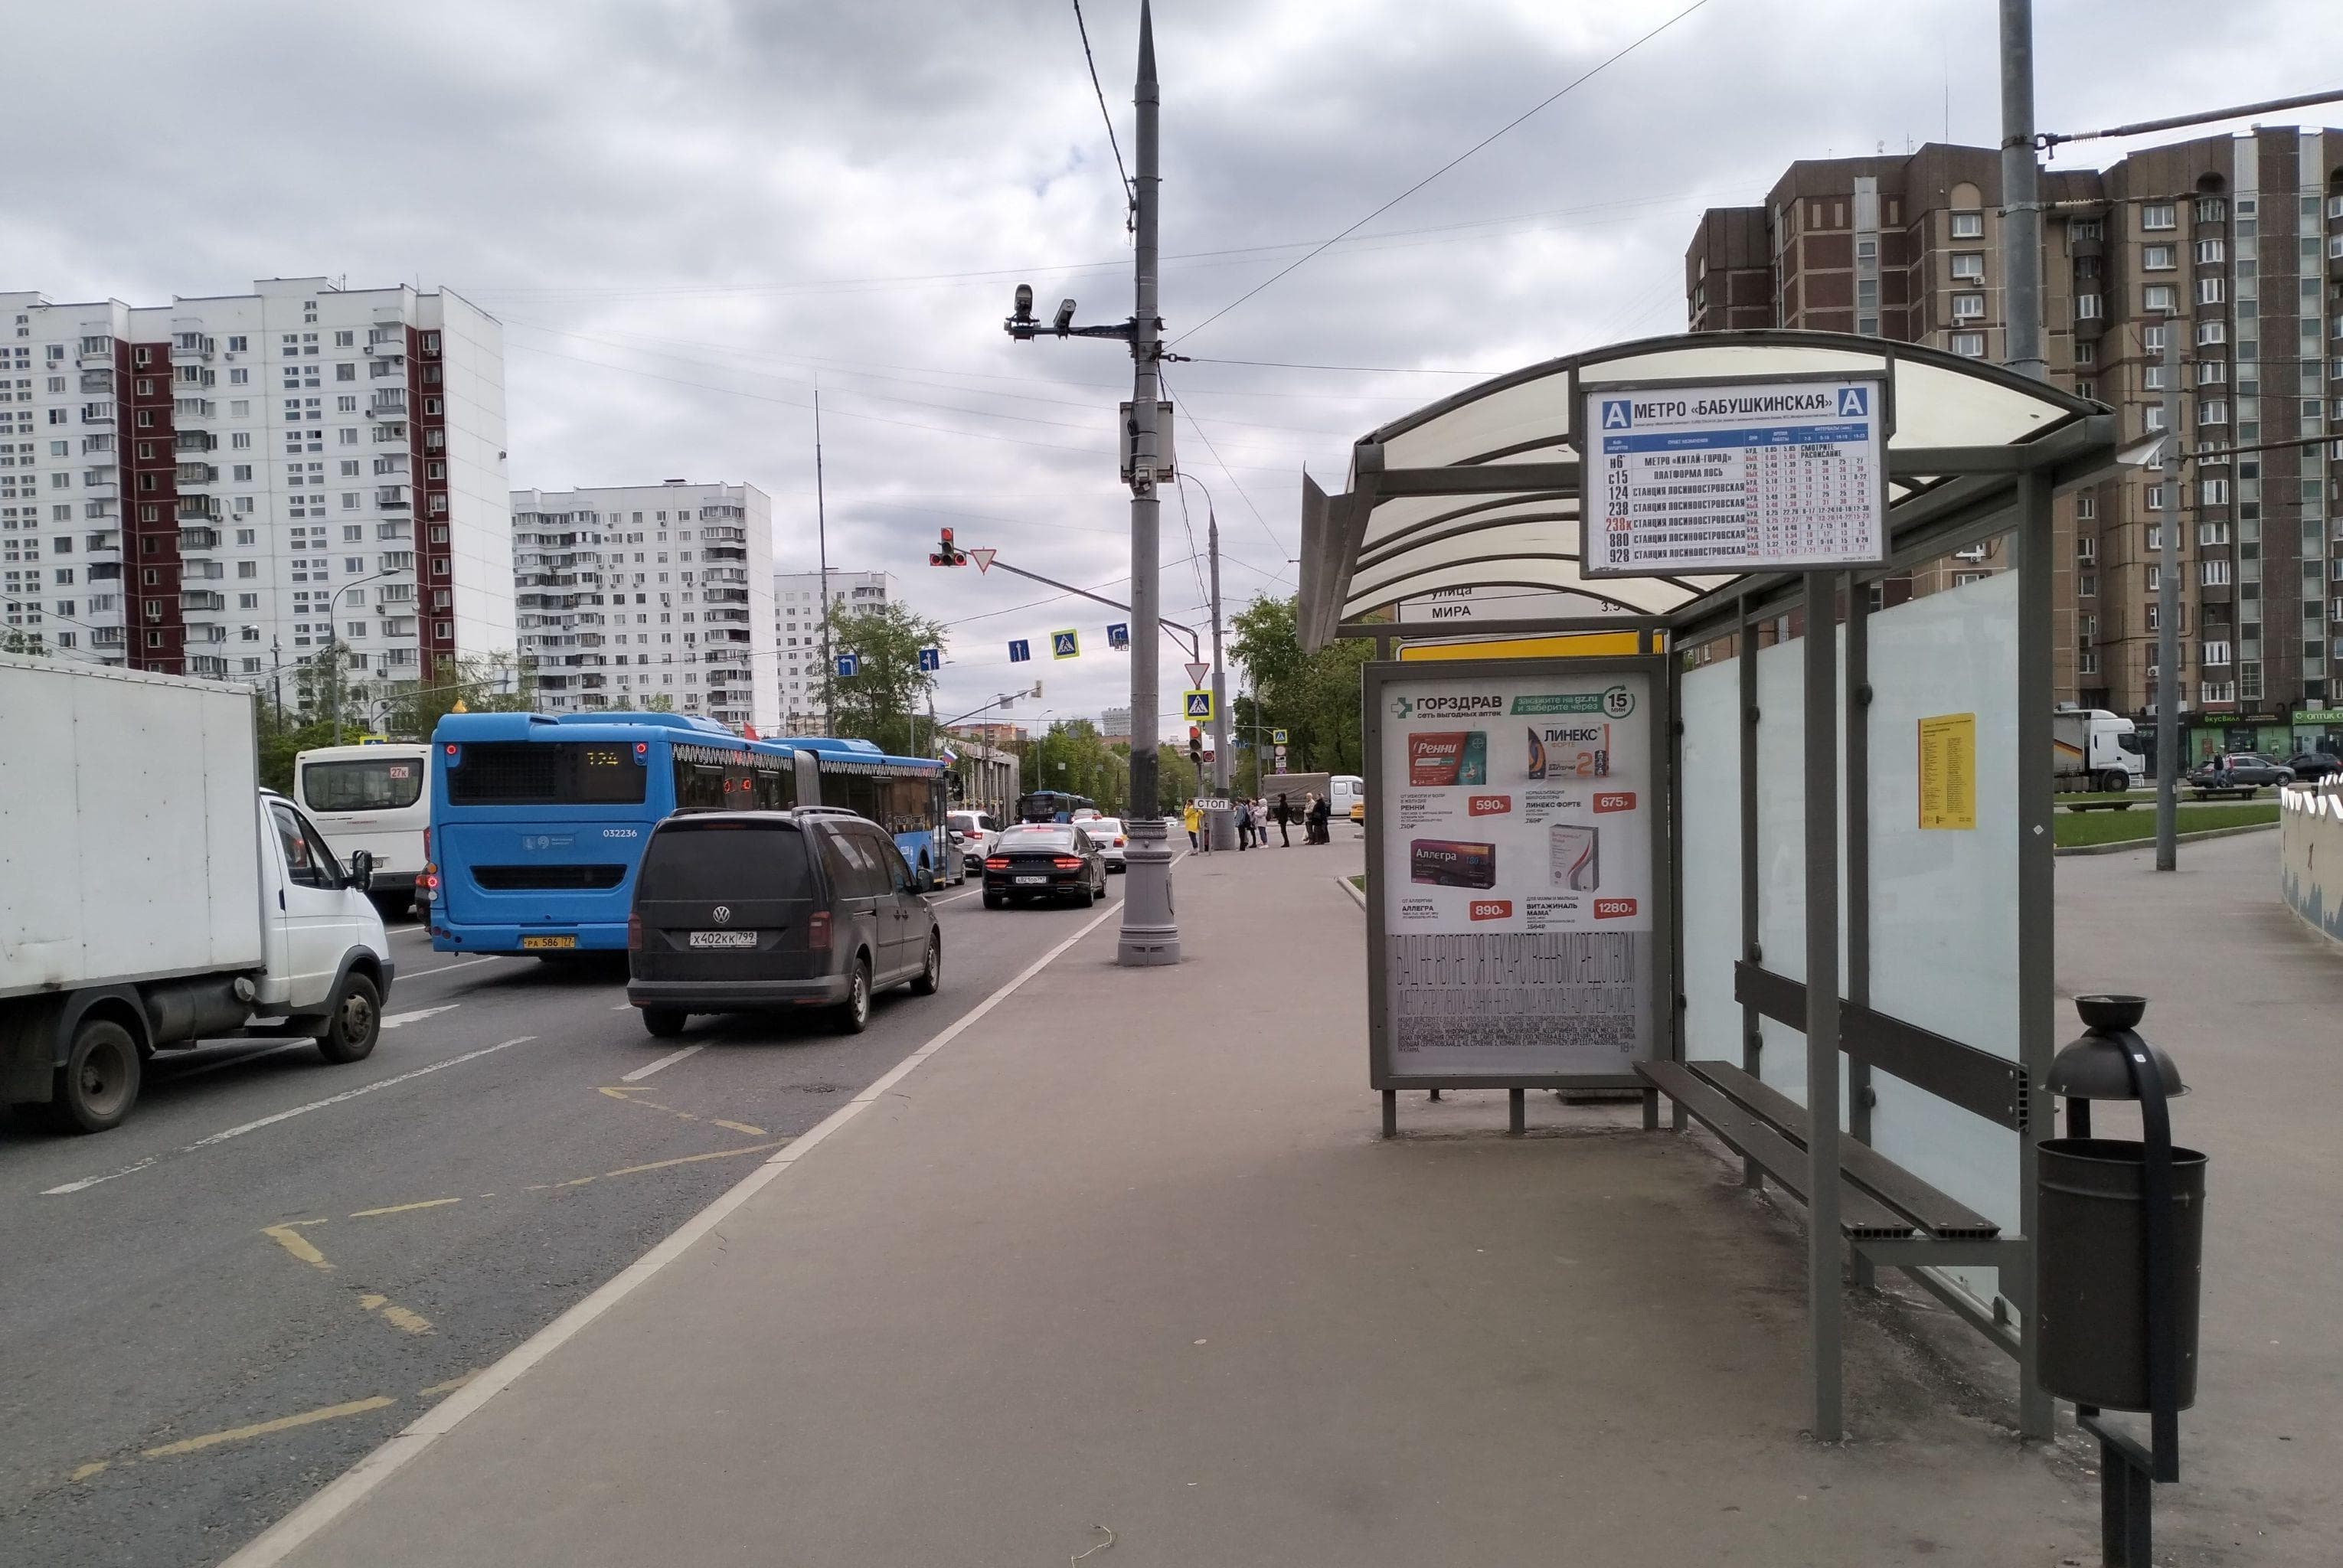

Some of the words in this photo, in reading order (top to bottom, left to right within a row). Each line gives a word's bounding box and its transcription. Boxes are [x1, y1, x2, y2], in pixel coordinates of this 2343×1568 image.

[1604, 403, 1628, 428] А
[1634, 401, 1686, 419] МЕТРО
[1691, 394, 1832, 416] «БАБУШКИНСКАЯ»
[1645, 456, 1670, 466] МЕТРО
[1672, 453, 1732, 464] «КИТАЙ-ГОРОД»
[1608, 470, 1628, 485] с15
[1654, 469, 1702, 479] ПЛАТФОРМА
[1704, 468, 1724, 477] ЛОСЬ
[1609, 486, 1629, 500] 124
[1632, 487, 1666, 497] СТАНЦИЯ
[1668, 482, 1744, 495] ЛОСИНООСТРОВСКАЯ
[1609, 501, 1629, 516] 238
[1633, 503, 1666, 513] СТАНЦИЯ
[1668, 498, 1745, 511] ЛОСИНООСТРОВСКАЯ
[1606, 518, 1632, 532] 238к
[1633, 518, 1667, 528] СТАНЦИЯ
[1669, 514, 1745, 526] ЛОСИНООСТРОВСКАЯ
[1609, 533, 1629, 547] 880
[1634, 534, 1667, 544] СТАНЦИЯ
[1669, 530, 1745, 541] ЛОСИНООСТРОВСКАЯ
[1610, 549, 1629, 563] 928
[1635, 549, 1667, 560] СТАНЦИЯ
[1669, 546, 1746, 557] ЛОСИНООСТРОВСКАЯ
[1432, 587, 1472, 600] улица
[1432, 605, 1472, 618] МИРА
[1417, 696, 1502, 710] ГОРЗДРАВ
[1574, 696, 1598, 704] gz.ru
[1608, 693, 1628, 707] 15
[1526, 704, 1569, 713] заберите
[1418, 742, 1458, 754] Ренни
[1576, 752, 1593, 775] 2
[1198, 799, 1225, 808] СТОП
[603, 829, 637, 838] 032236
[1416, 848, 1457, 862] Аллегра
[542, 938, 558, 946] 586
[737, 933, 754, 941] 799
[1619, 1042, 1635, 1053] 18+
